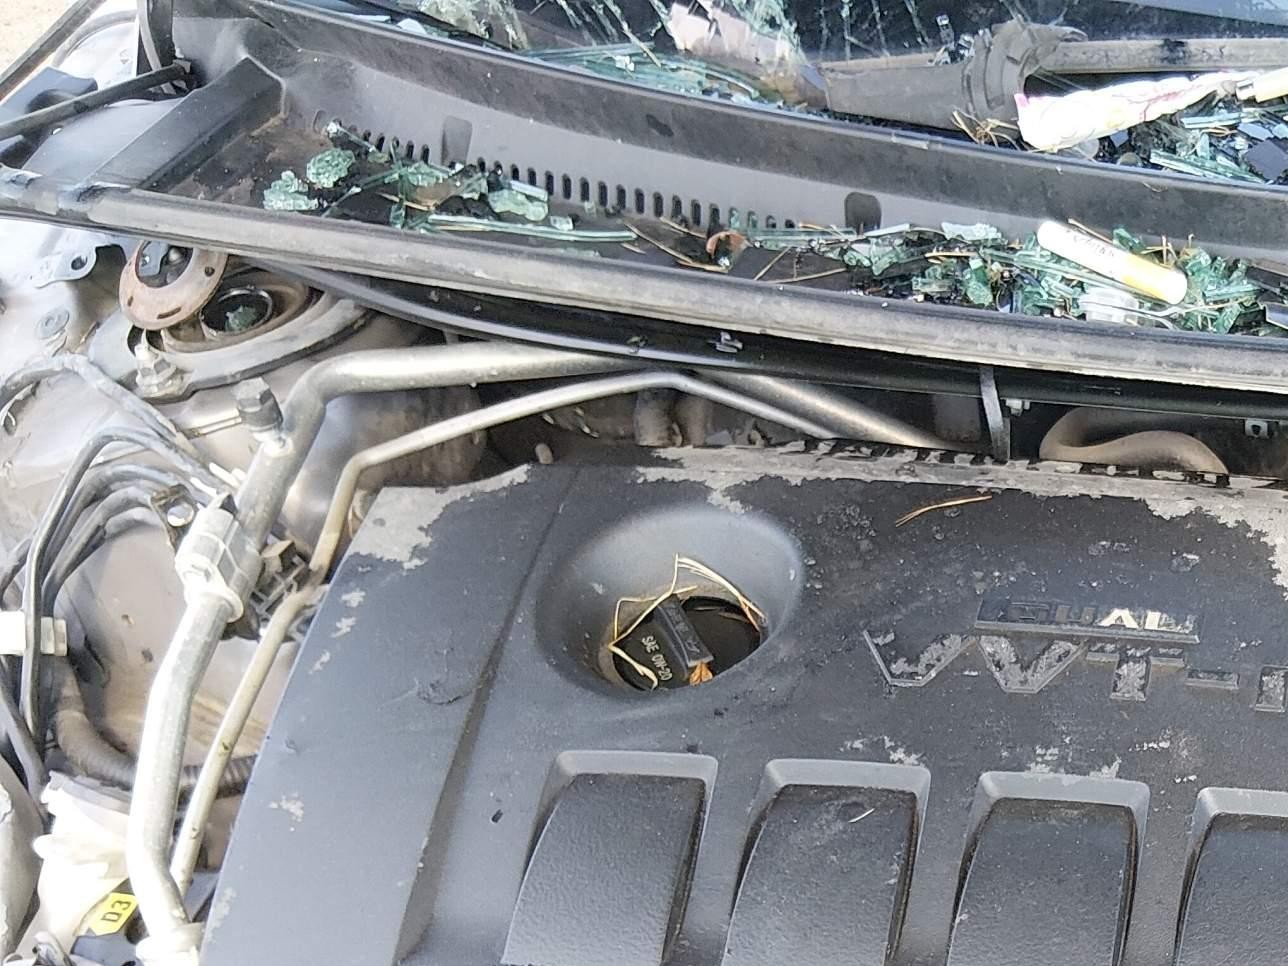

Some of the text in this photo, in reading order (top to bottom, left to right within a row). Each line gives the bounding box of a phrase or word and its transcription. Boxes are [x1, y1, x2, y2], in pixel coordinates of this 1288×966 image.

[642, 635, 674, 681] SAE 0W-20
[101, 899, 132, 923] D3
